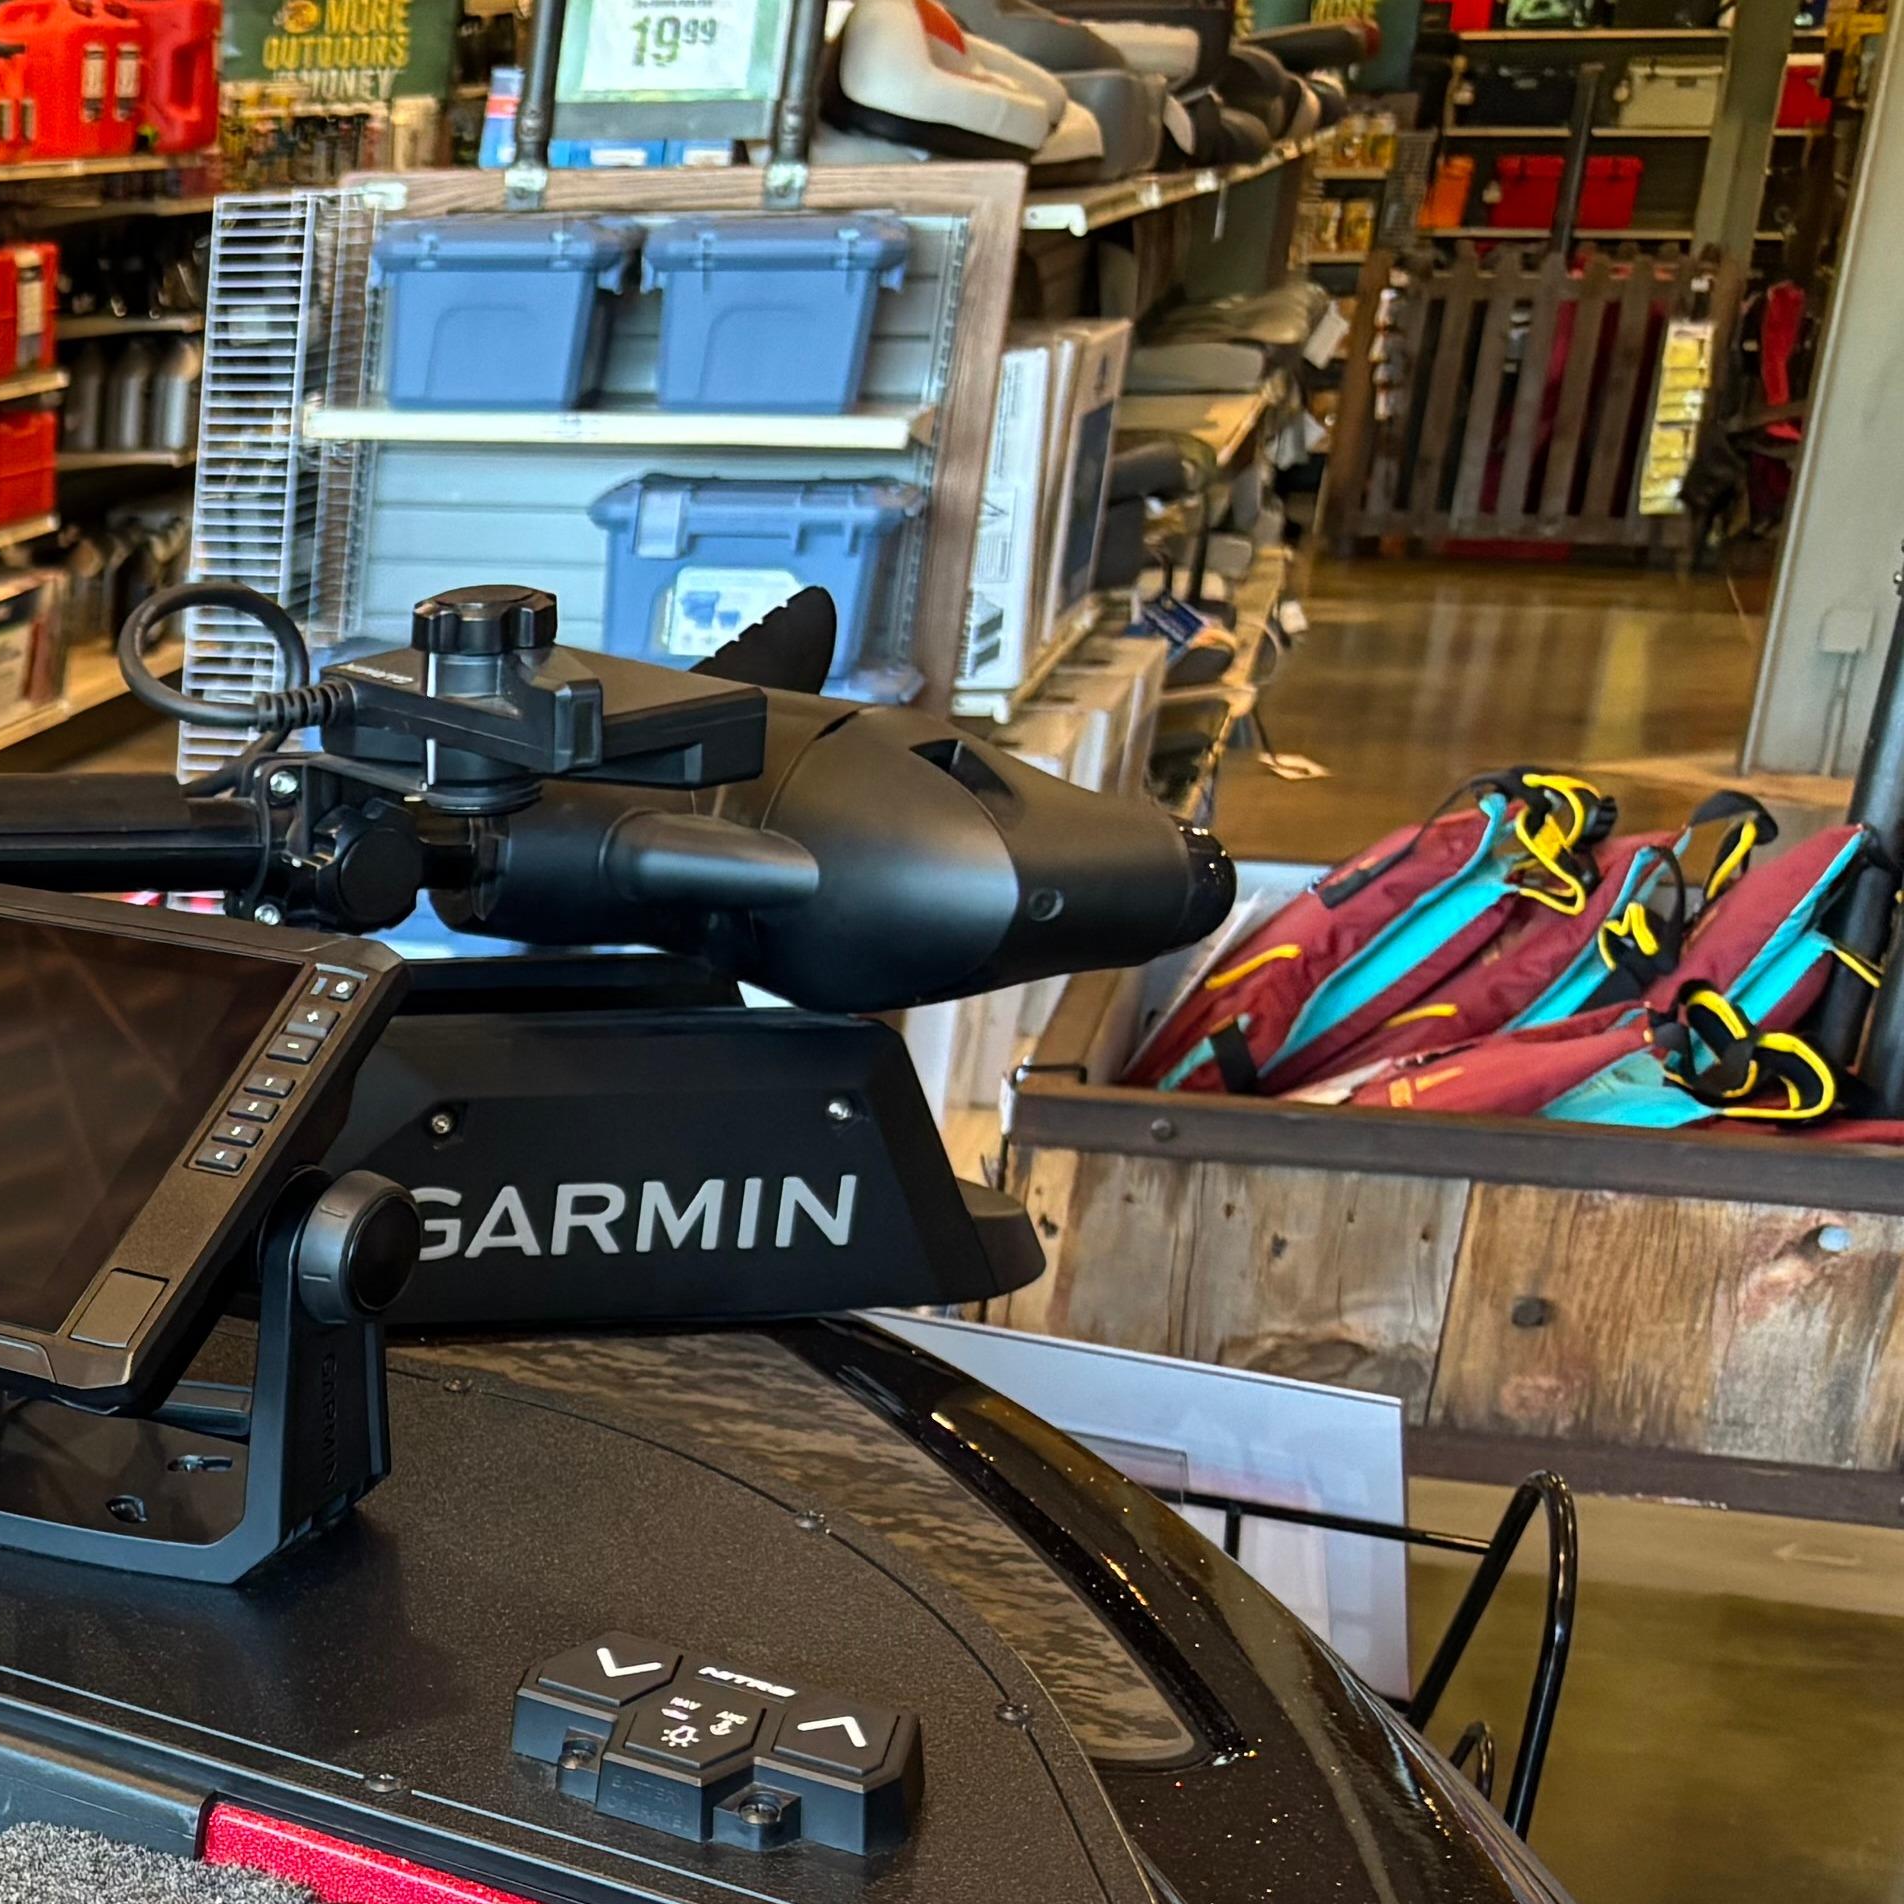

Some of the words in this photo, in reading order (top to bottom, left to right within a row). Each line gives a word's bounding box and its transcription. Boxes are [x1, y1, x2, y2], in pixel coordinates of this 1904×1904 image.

[324, 0, 411, 34] MORE
[261, 35, 411, 70] OUTDOORS
[409, 1174, 858, 1262] GARMIN
[320, 1353, 339, 1488] GARMIN
[697, 1665, 798, 1698] NITRO
